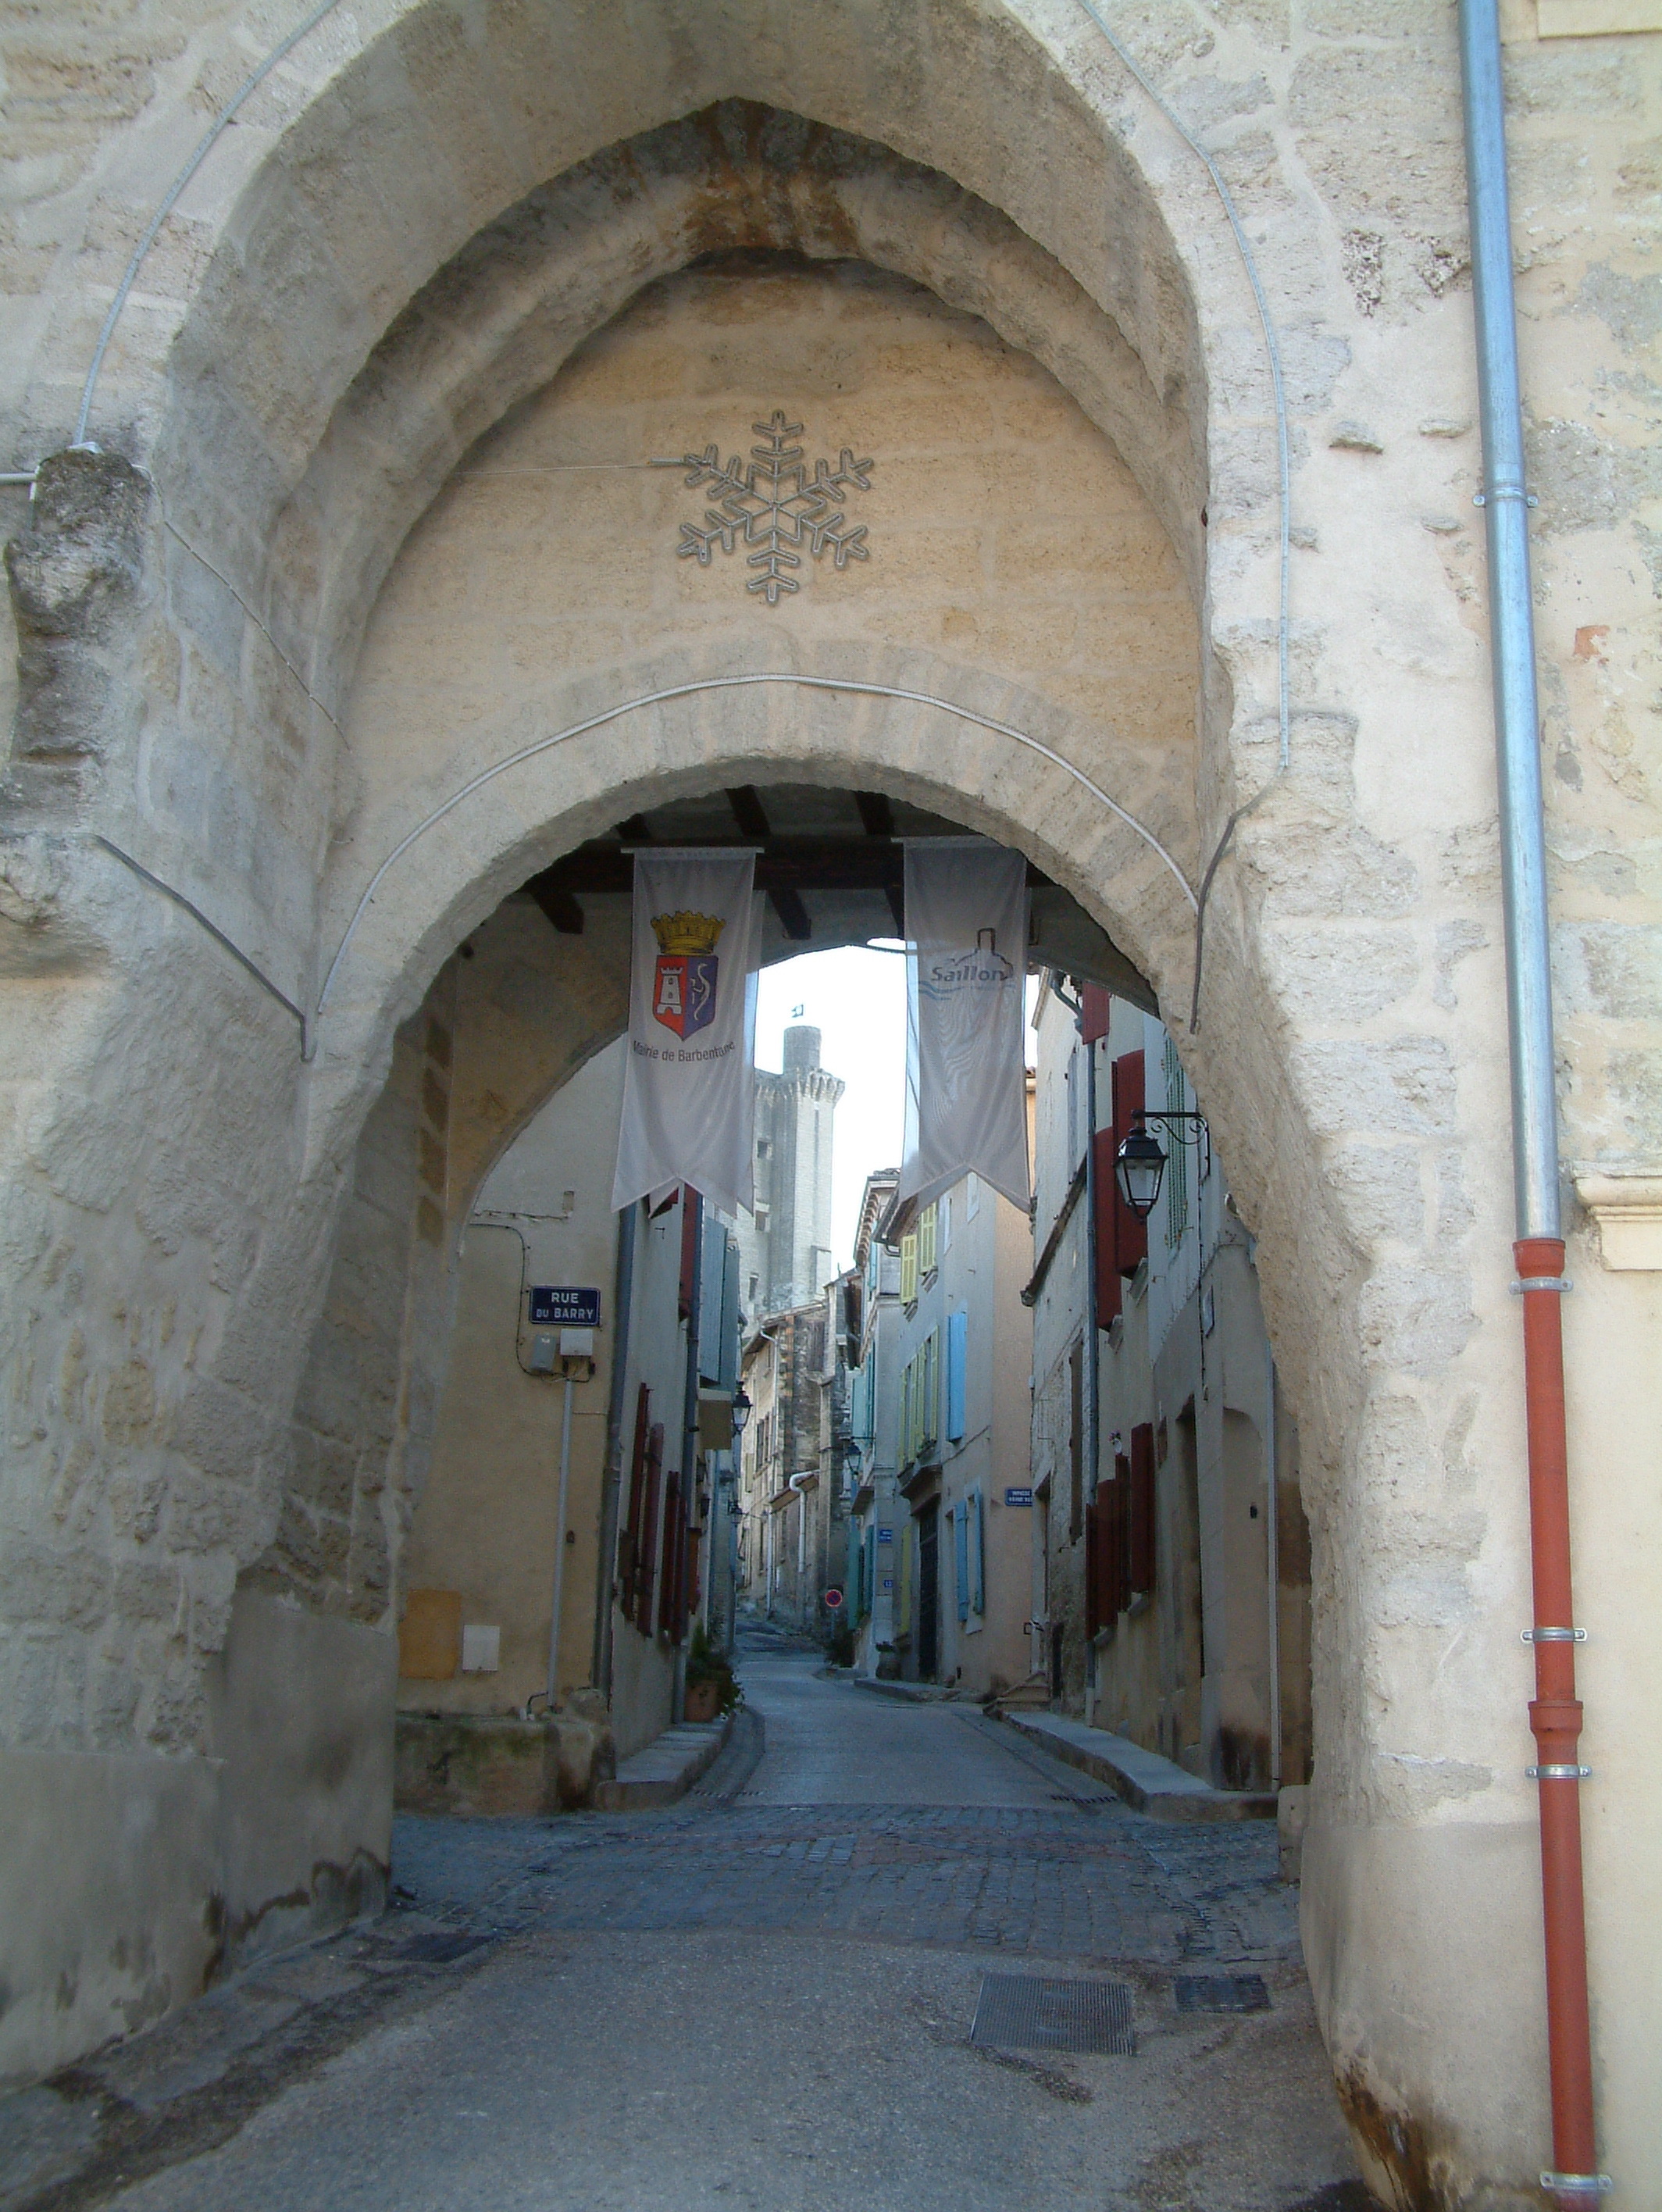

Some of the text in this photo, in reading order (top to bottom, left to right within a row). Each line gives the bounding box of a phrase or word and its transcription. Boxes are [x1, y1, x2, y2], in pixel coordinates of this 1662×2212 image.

[930, 965, 1008, 982] Saillon
[633, 1040, 736, 1062] Mairie de Barbentane
[551, 1292, 580, 1304] RUE
[536, 1308, 594, 1319] DU BARRY
